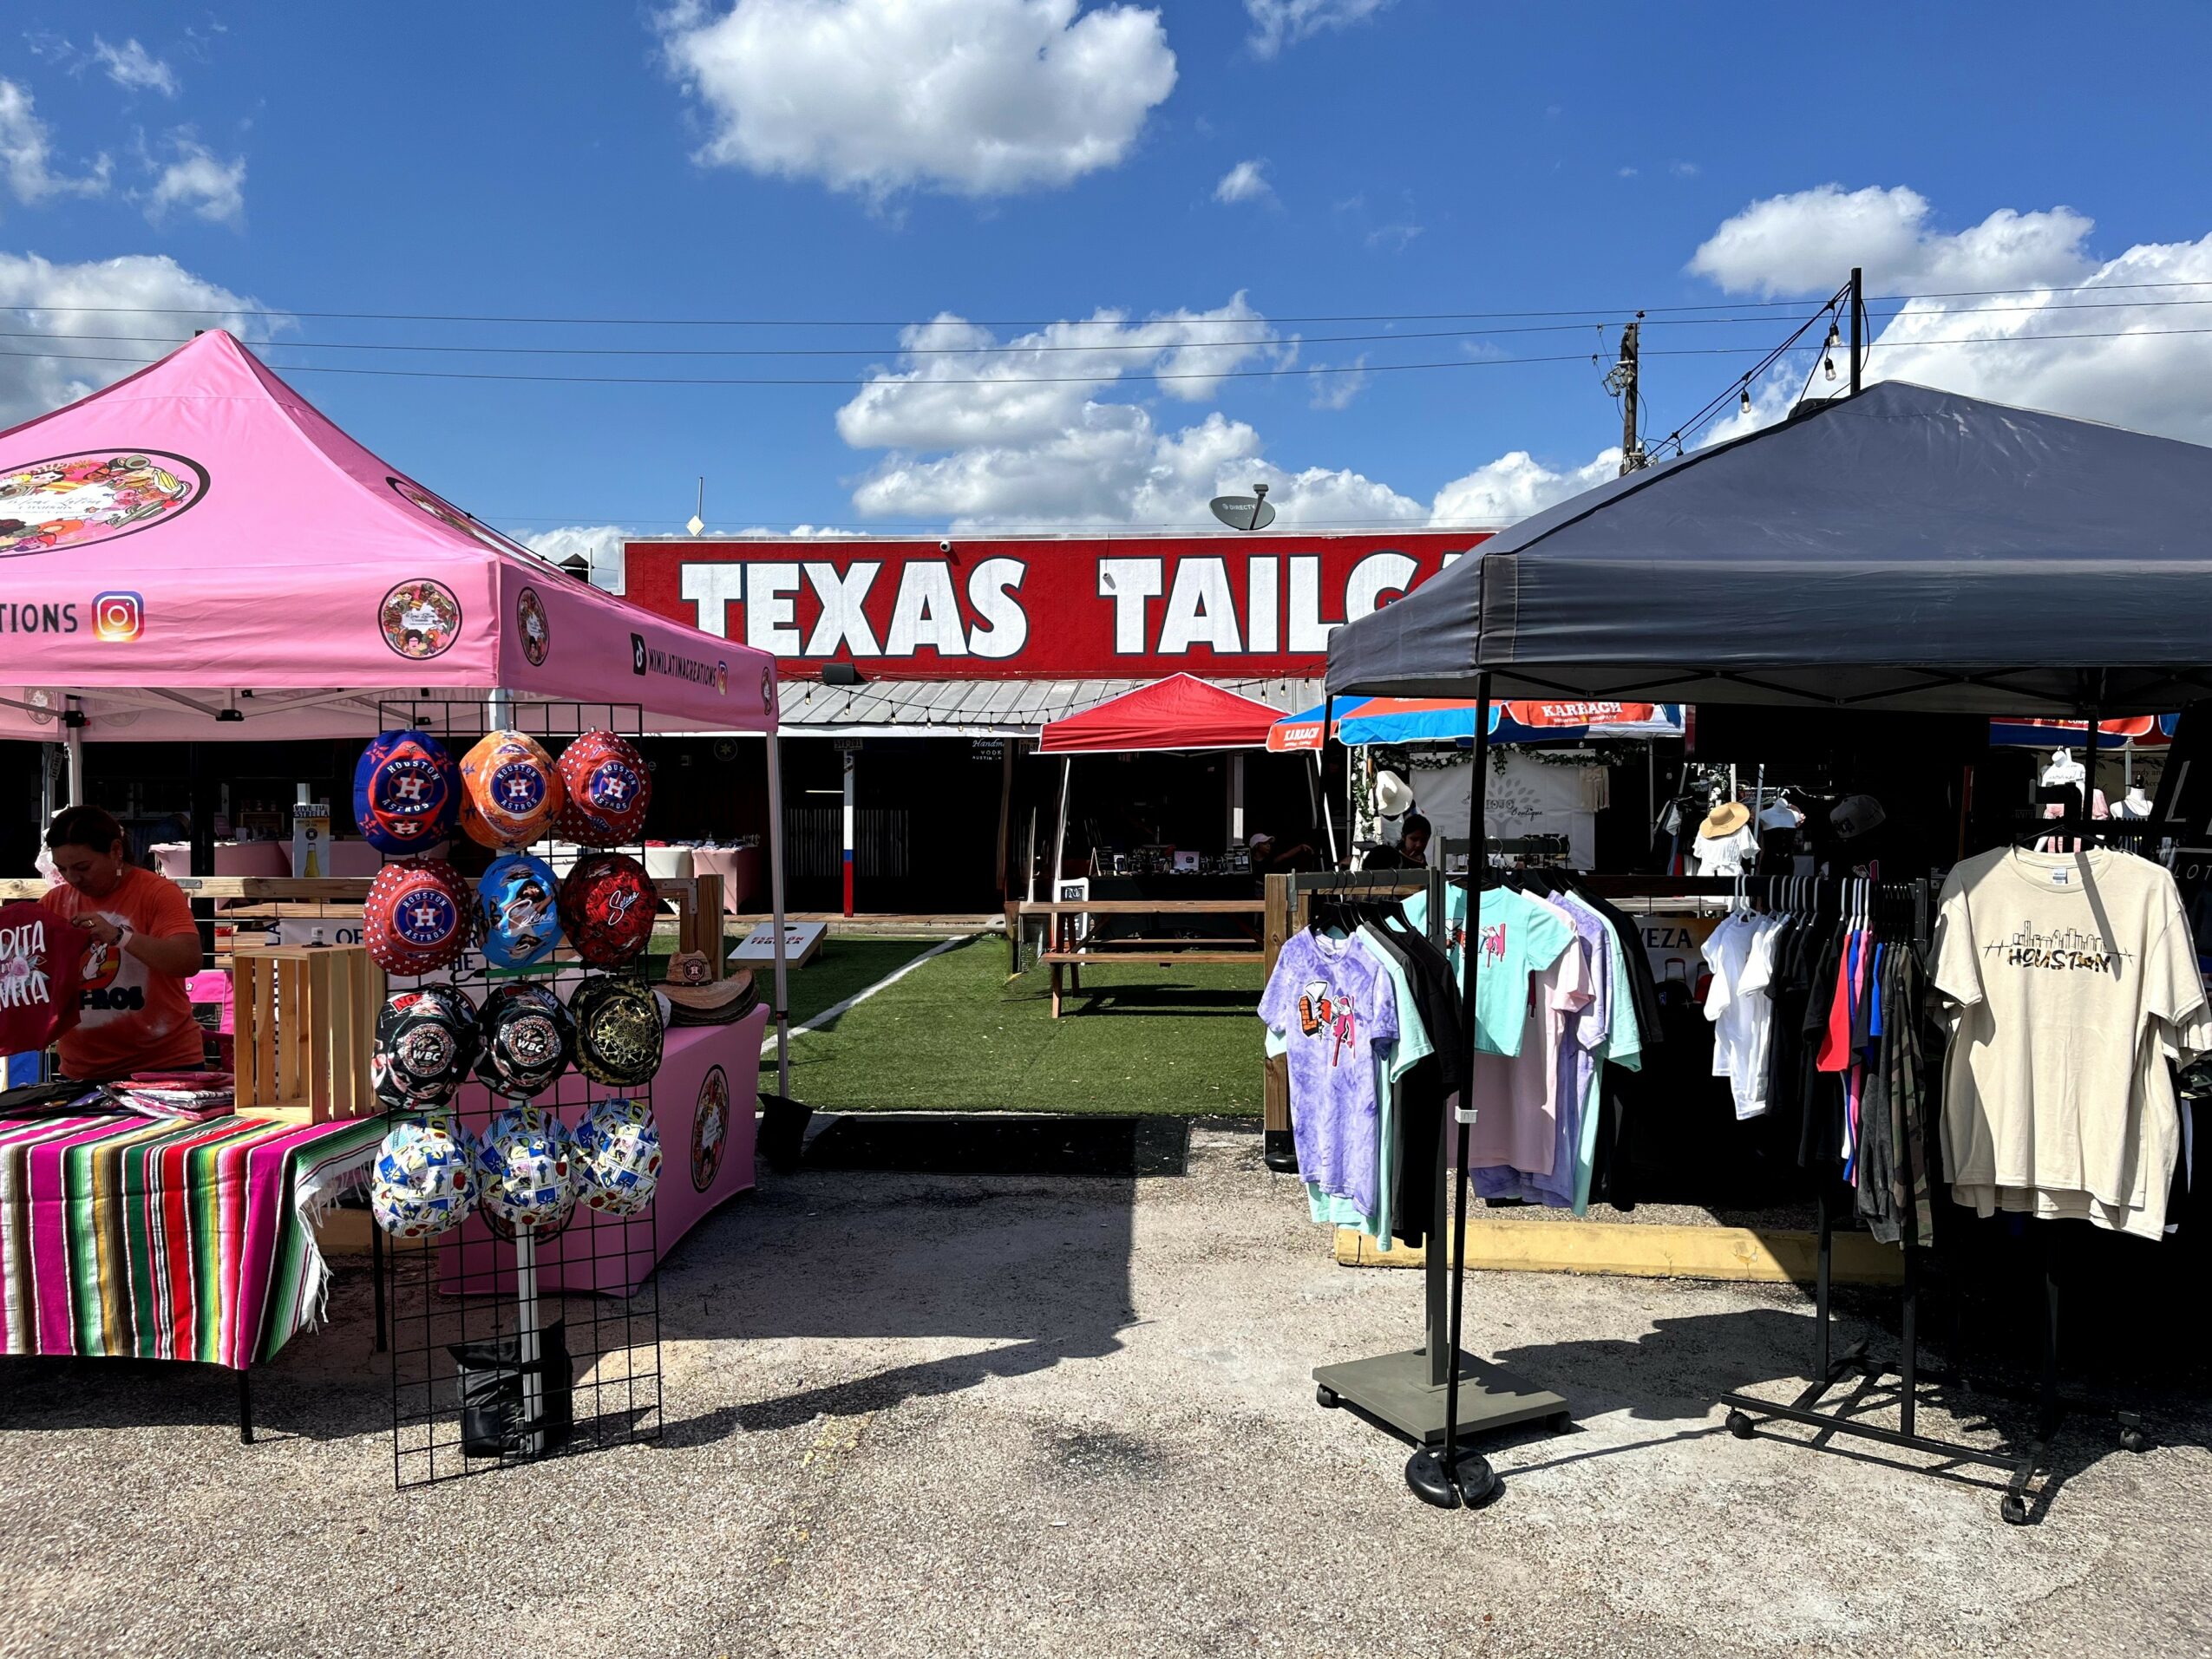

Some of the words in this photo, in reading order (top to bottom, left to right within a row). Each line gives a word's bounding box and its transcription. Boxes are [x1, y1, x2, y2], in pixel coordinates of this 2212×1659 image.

[679, 557, 1030, 660] TEXAS
[1097, 551, 1468, 655] TAILG
[648, 648, 717, 688] MIMILATINACREATIONS
[1541, 702, 1623, 716] KARBACH
[972, 738, 1005, 748] Handm
[387, 761, 441, 781] HOUSTON
[496, 764, 537, 780] HOUSTON
[602, 764, 637, 786] HOUSTON
[396, 776, 425, 800] H
[507, 779, 528, 797] H
[605, 776, 627, 799] H
[382, 798, 429, 813] ASTROS
[501, 797, 538, 811] ASTROS
[593, 793, 627, 809] ASTROS
[402, 892, 448, 908] HOUSTON
[608, 890, 640, 926] Selena
[415, 908, 436, 927] H
[506, 898, 556, 929] Selena
[404, 927, 446, 942] ASTROS
[517, 1039, 545, 1053] WBC
[413, 1049, 442, 1062] WBC
